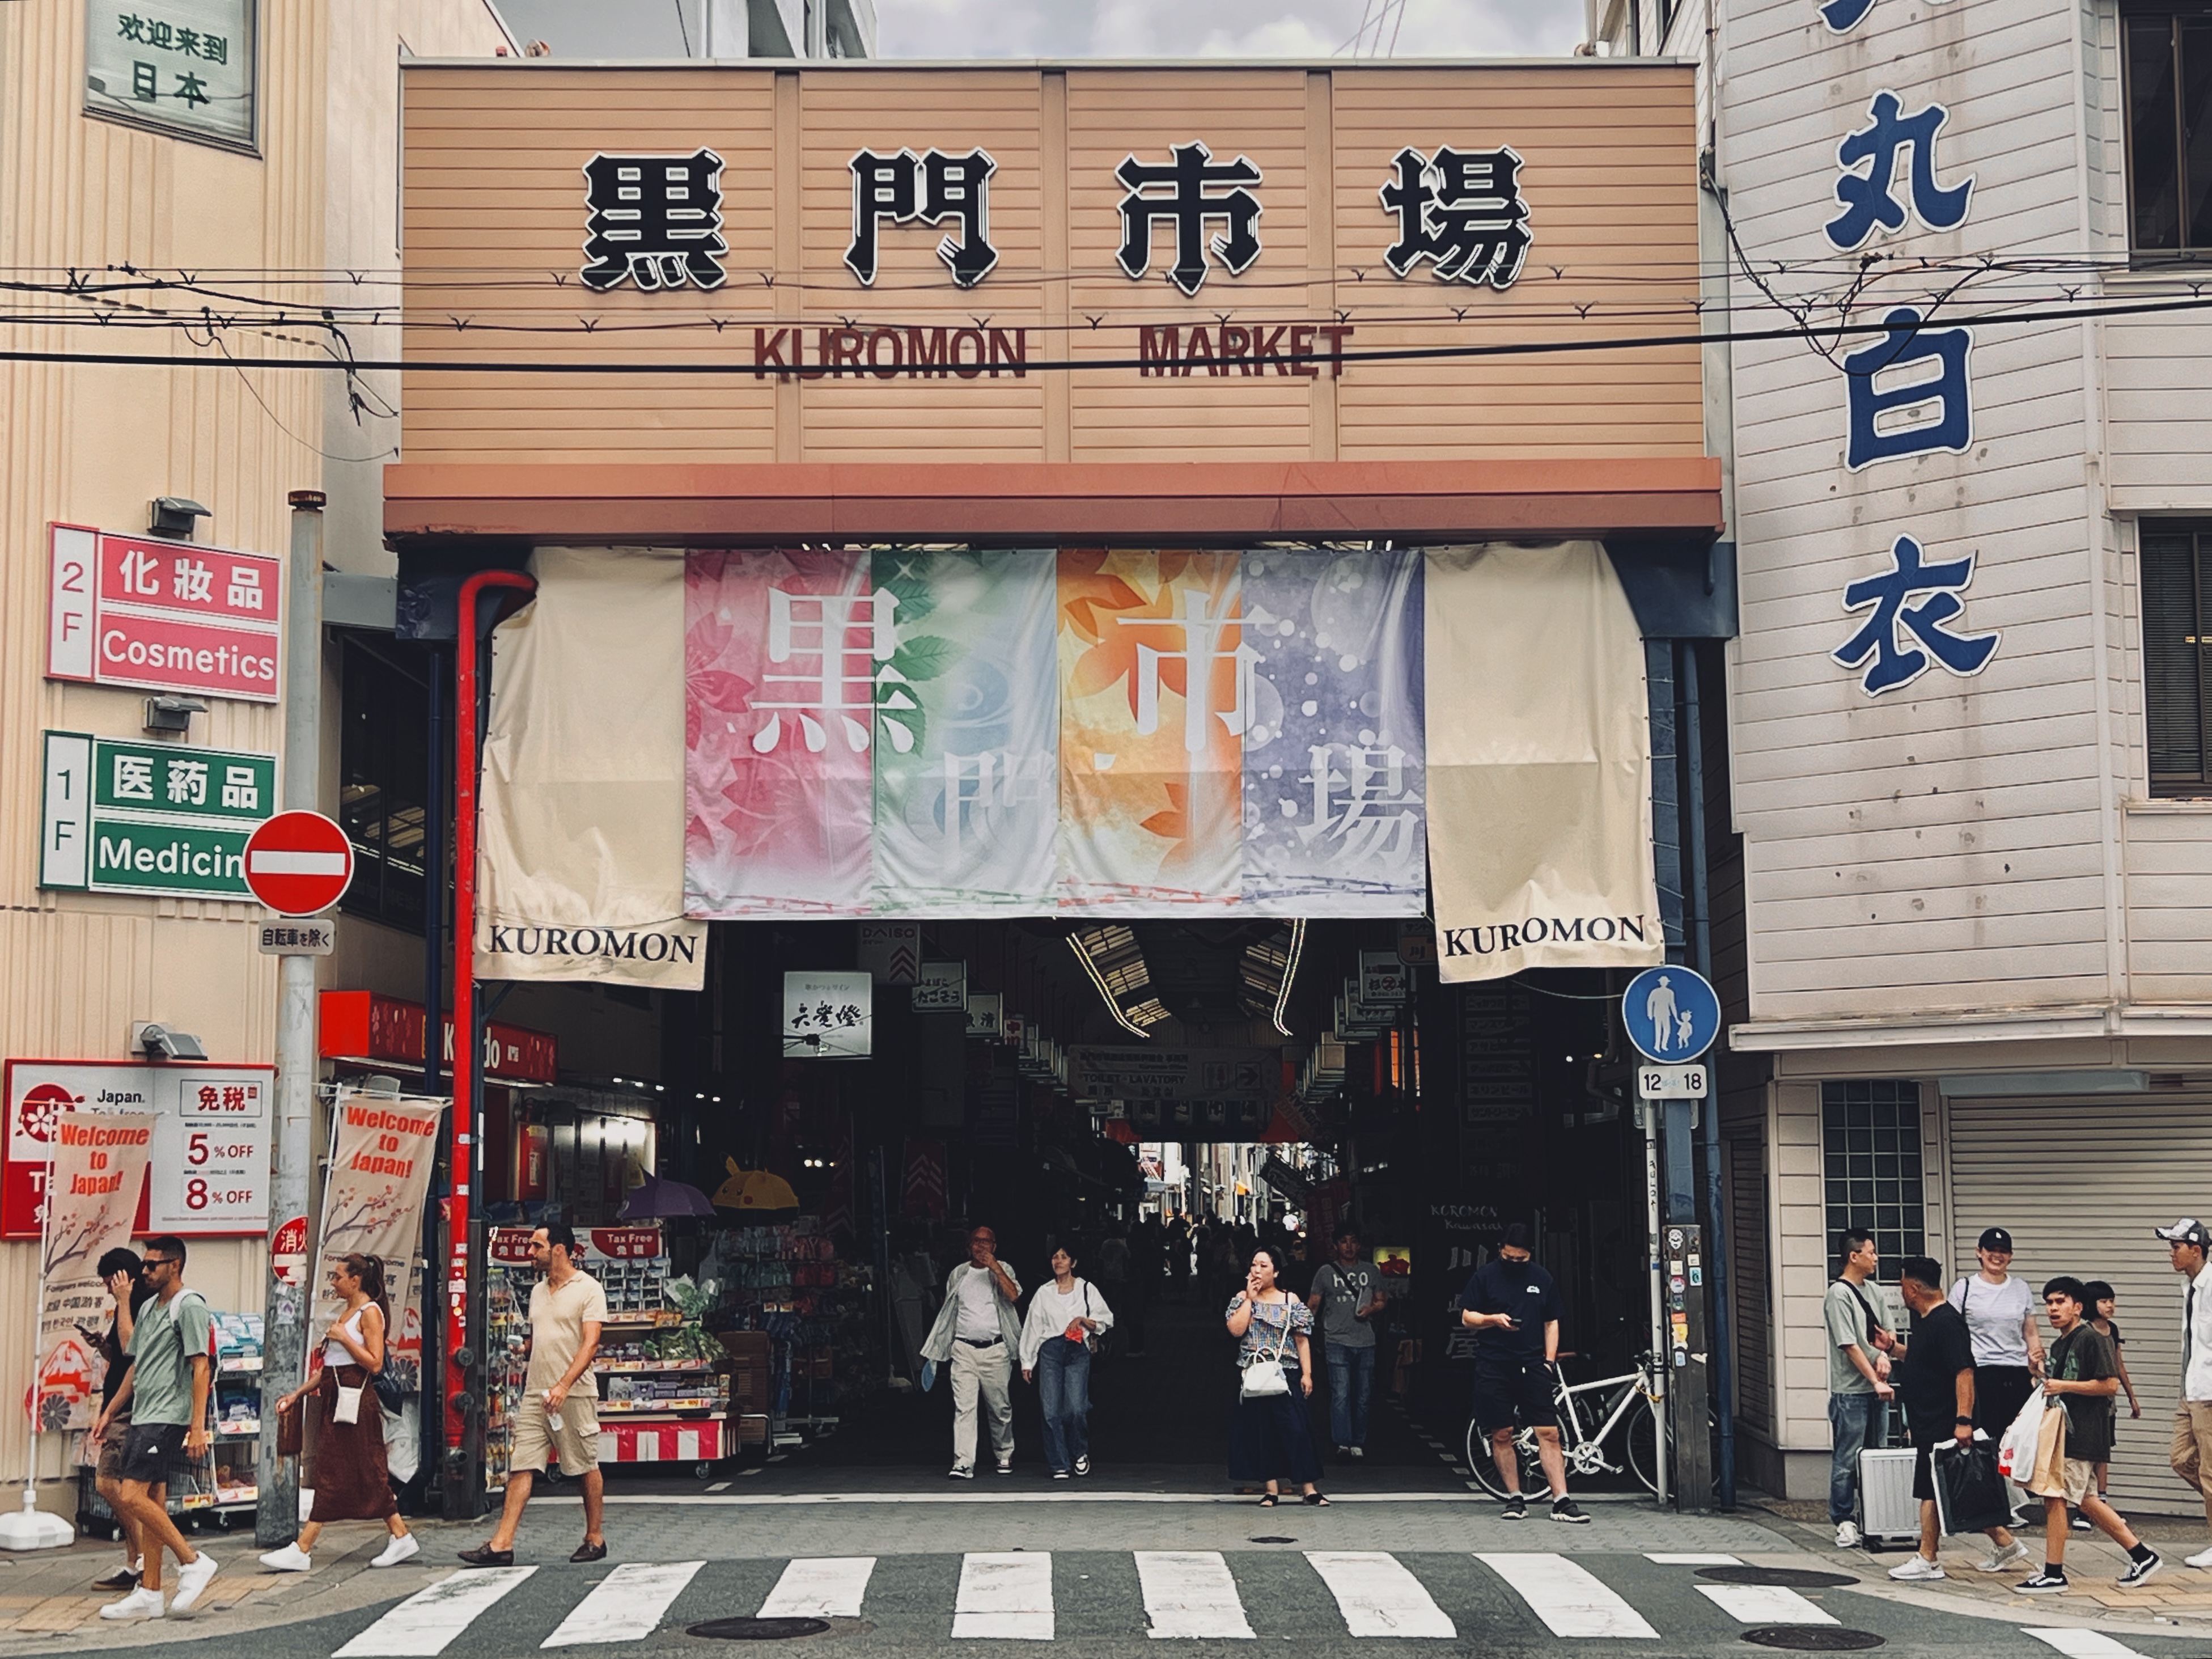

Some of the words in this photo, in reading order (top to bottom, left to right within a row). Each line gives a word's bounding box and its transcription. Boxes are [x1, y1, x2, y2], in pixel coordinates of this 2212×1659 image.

[117, 13, 227, 65] 欢迎来到
[133, 60, 210, 109] 日本
[579, 140, 1534, 296] 黒門市場
[753, 327, 1027, 380] KUROMON
[1140, 325, 1354, 378] MARKET
[1816, 0, 2002, 698] 丸白衣
[103, 630, 275, 681] Cosmetics
[99, 836, 244, 879] Medicin
[262, 928, 329, 947] 自転車を除く
[489, 925, 698, 963] KUROMON
[1443, 915, 1645, 957] KUROMON
[198, 1085, 245, 1111] 免税
[1644, 1074, 1661, 1091] 12
[1684, 1073, 1702, 1090] 18
[61, 1124, 150, 1146] Welcome
[348, 1106, 435, 1137] Welcome
[188, 1133, 209, 1165] 5
[214, 1146, 225, 1158] %
[228, 1145, 254, 1158] OFF
[379, 1134, 399, 1152] to
[90, 1151, 108, 1170] to
[350, 1150, 414, 1179] Japan!
[70, 1171, 124, 1196] Japan!
[186, 1178, 208, 1210] 8
[212, 1192, 223, 1204] %
[227, 1191, 253, 1204] OFF
